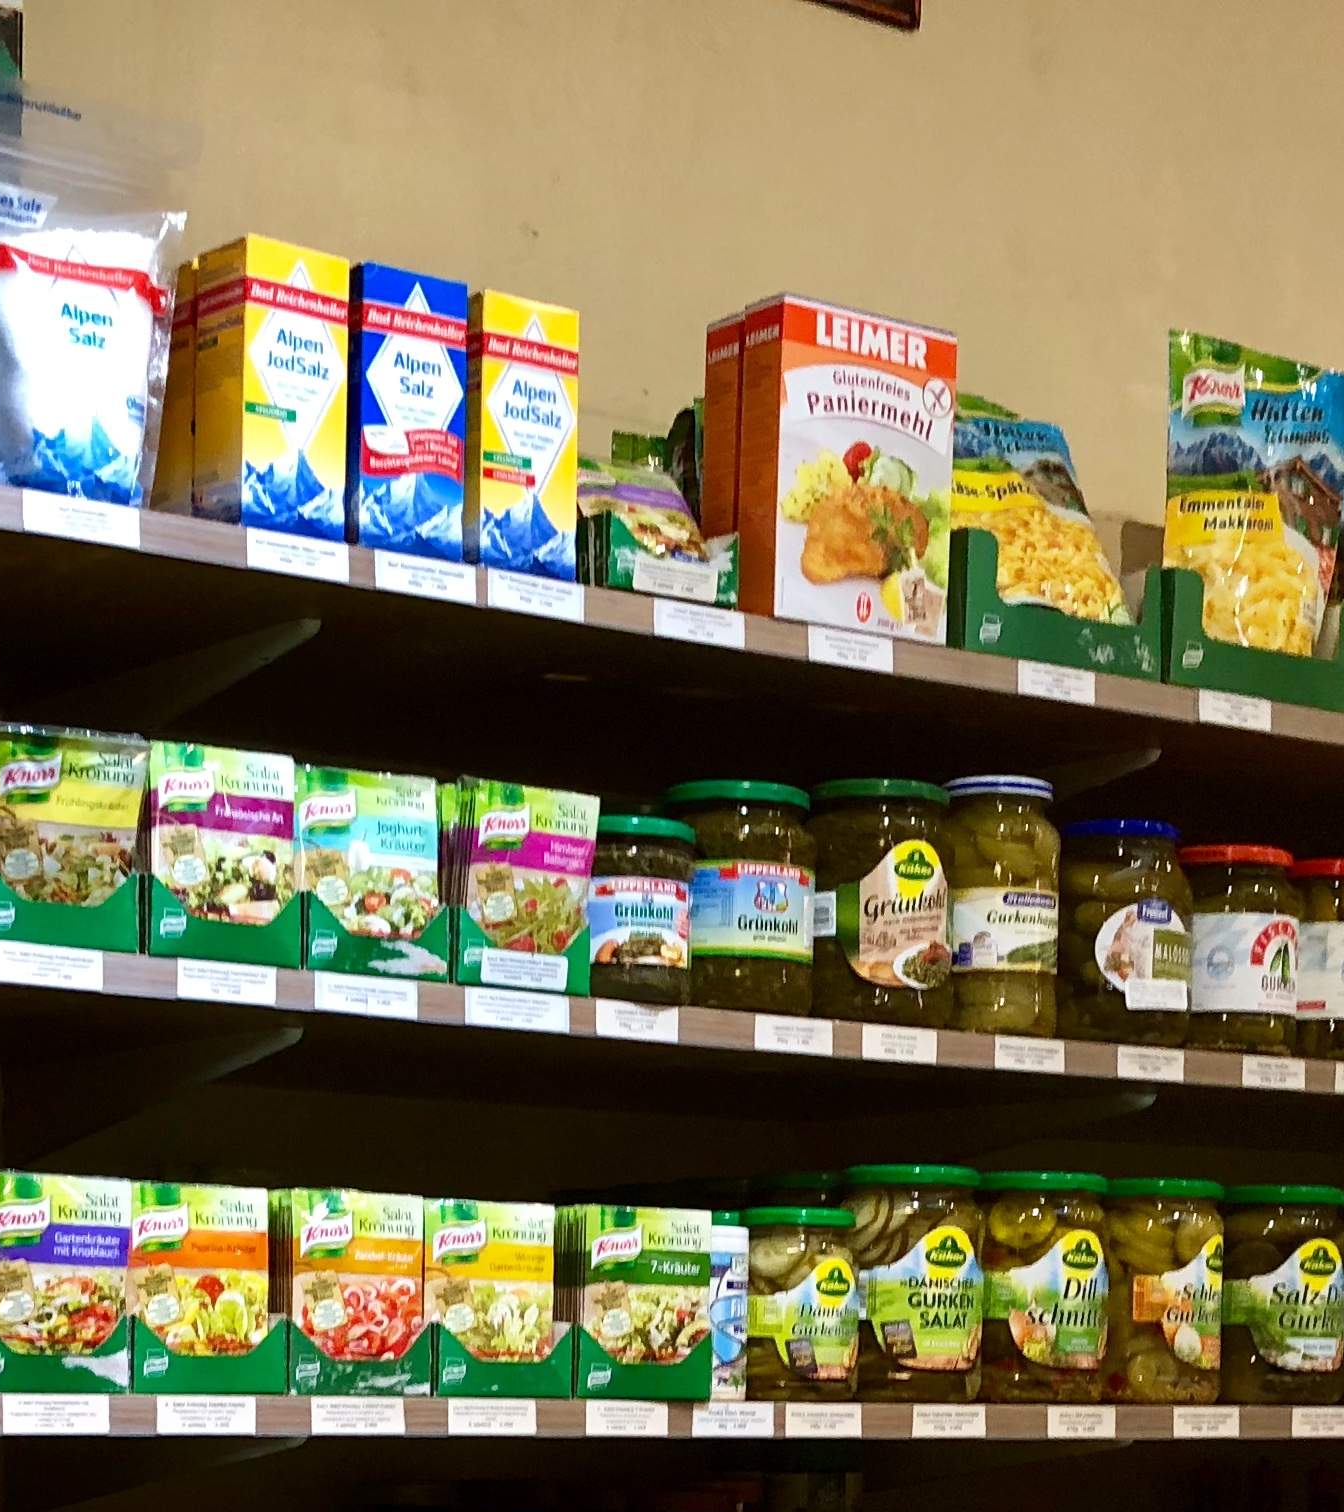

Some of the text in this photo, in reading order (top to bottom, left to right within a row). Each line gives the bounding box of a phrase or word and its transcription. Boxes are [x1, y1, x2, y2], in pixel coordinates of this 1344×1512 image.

[250, 282, 348, 321] Bad Reichenhaller
[60, 302, 113, 329] Alpen
[367, 308, 465, 344] Bad Reichenhaller
[68, 327, 106, 350] Salz
[276, 327, 324, 357] Alpen
[745, 325, 780, 347] LEIMER
[816, 313, 927, 371] LEIMER
[267, 348, 330, 381] JodSalz
[393, 351, 443, 378] Alpen
[399, 375, 434, 399] Salz
[832, 369, 911, 402] Glutenfreies
[503, 400, 562, 430] JodSalz
[807, 391, 934, 442] Paniermehl
[5, 766, 56, 785] Knorr
[484, 813, 528, 834] Knorr
[380, 836, 427, 855] Kräuter
[613, 901, 675, 921] Grünkohl
[737, 913, 800, 936] Grünkohl
[597, 1234, 641, 1255] Knorr
[1063, 1275, 1098, 1301] Dill
